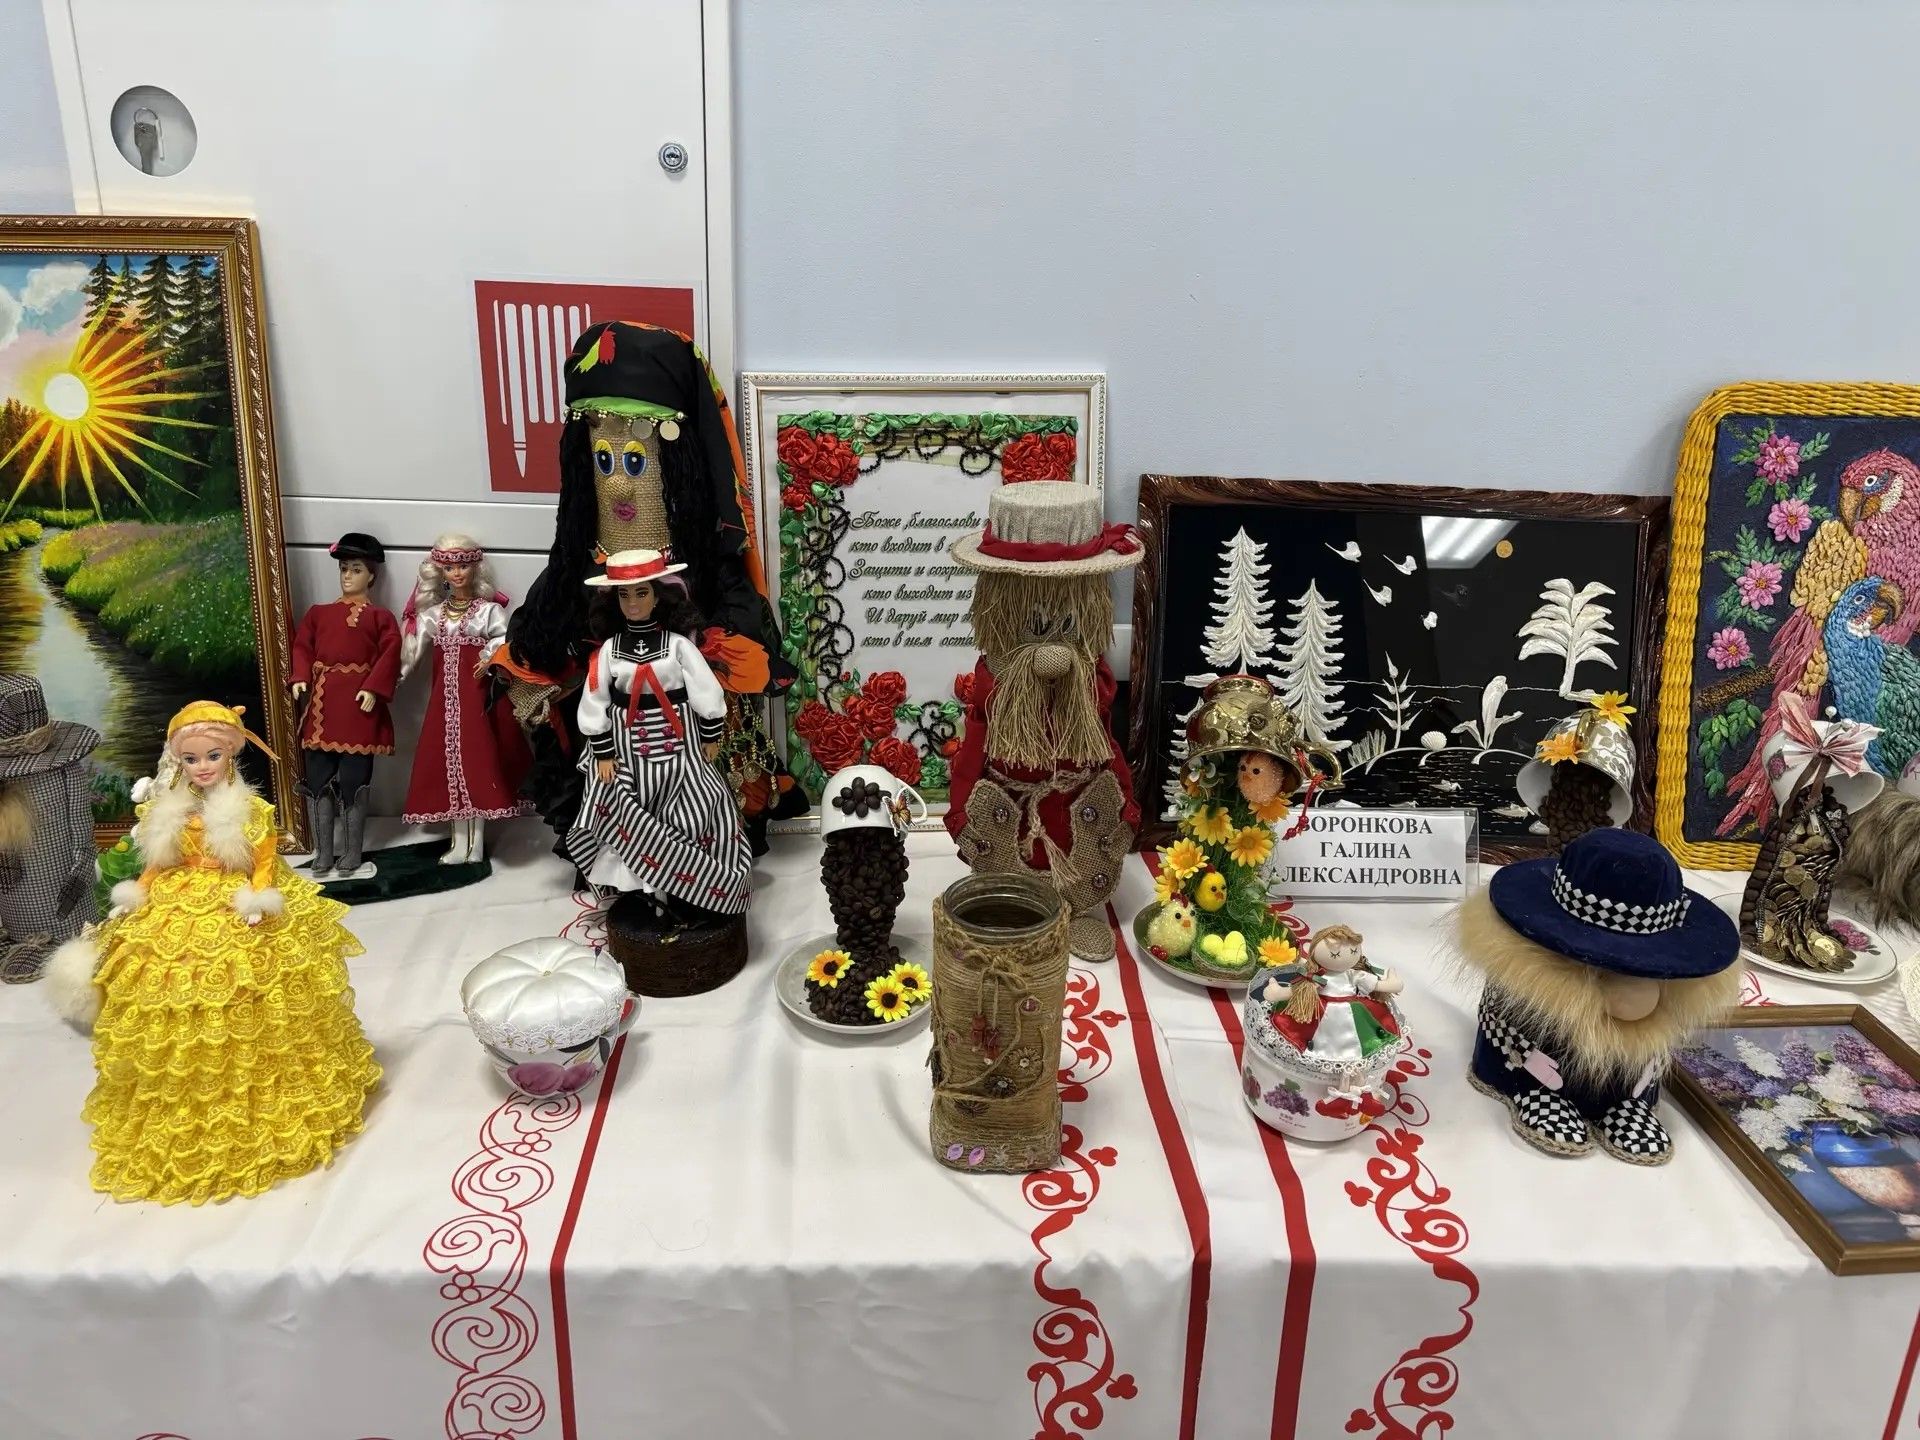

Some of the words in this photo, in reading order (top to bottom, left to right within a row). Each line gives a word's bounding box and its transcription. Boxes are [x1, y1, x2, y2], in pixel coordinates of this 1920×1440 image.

[851, 510, 901, 529] Боже
[850, 540, 878, 552] кто
[881, 536, 933, 552] входит
[934, 536, 946, 552] в
[849, 559, 911, 579] Защити
[914, 566, 926, 576] и
[863, 588, 892, 600] кто
[895, 584, 954, 600] выходит
[955, 589, 972, 600] из
[866, 607, 883, 623] И
[885, 608, 927, 630] даруй
[928, 613, 960, 629] мир
[861, 636, 890, 647] кто
[904, 637, 933, 647] нем
[1319, 841, 1412, 859] ГАЛИНА
